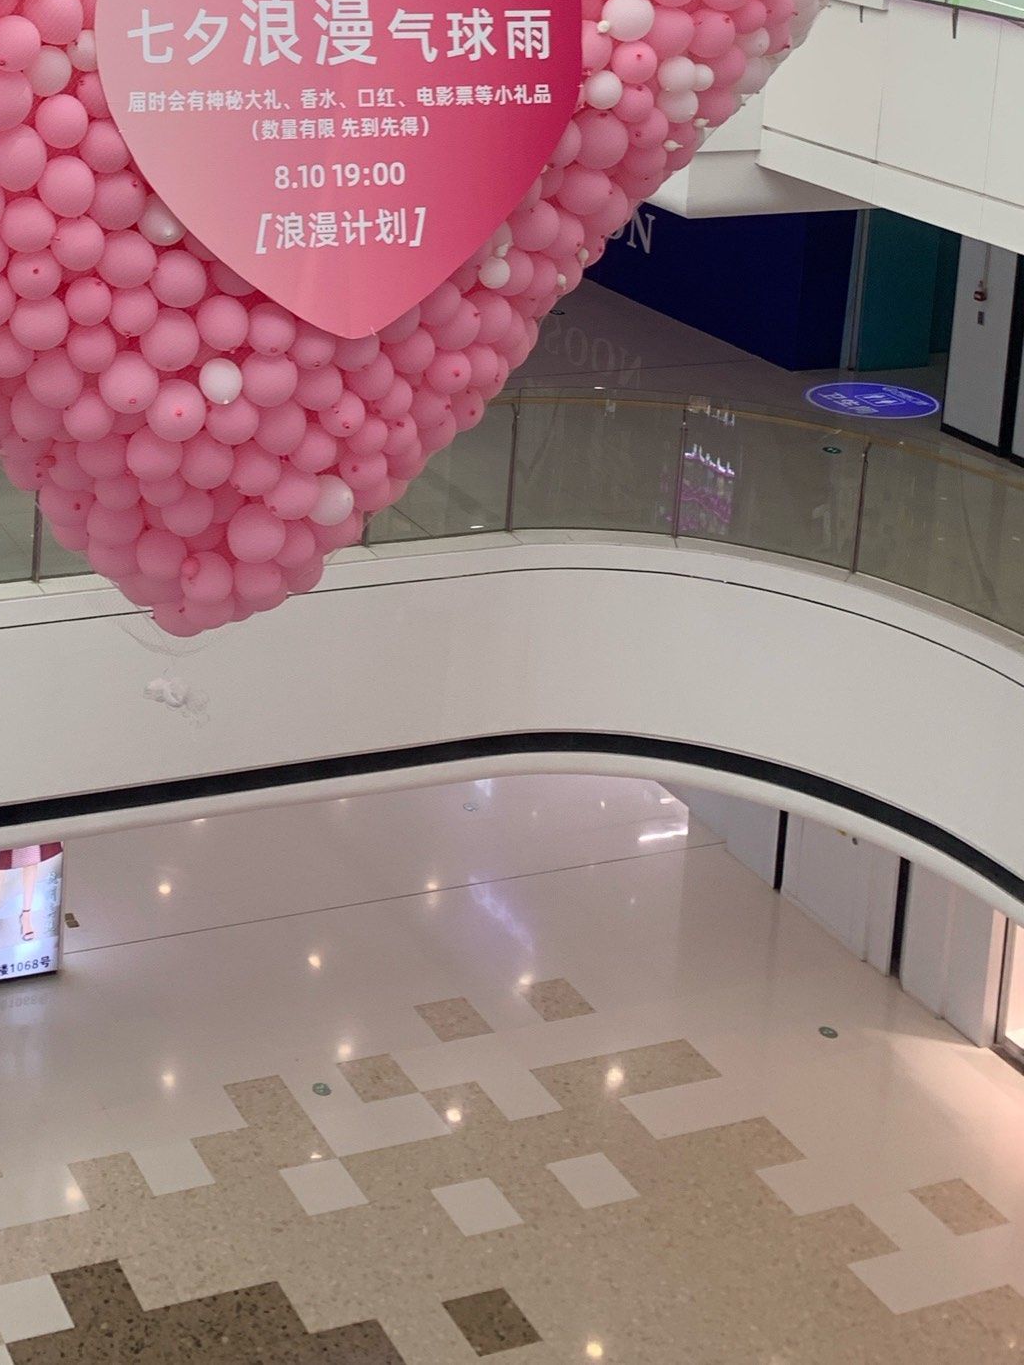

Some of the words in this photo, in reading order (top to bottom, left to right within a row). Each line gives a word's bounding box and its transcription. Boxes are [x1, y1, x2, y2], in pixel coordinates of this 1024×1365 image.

[127, 84, 553, 113] 届时会有神秘大礼、香水、口红、电影票等小礼品
[274, 164, 327, 190] 8.10
[331, 162, 406, 188] 19:00
[255, 207, 427, 255] [浪漫计划]
